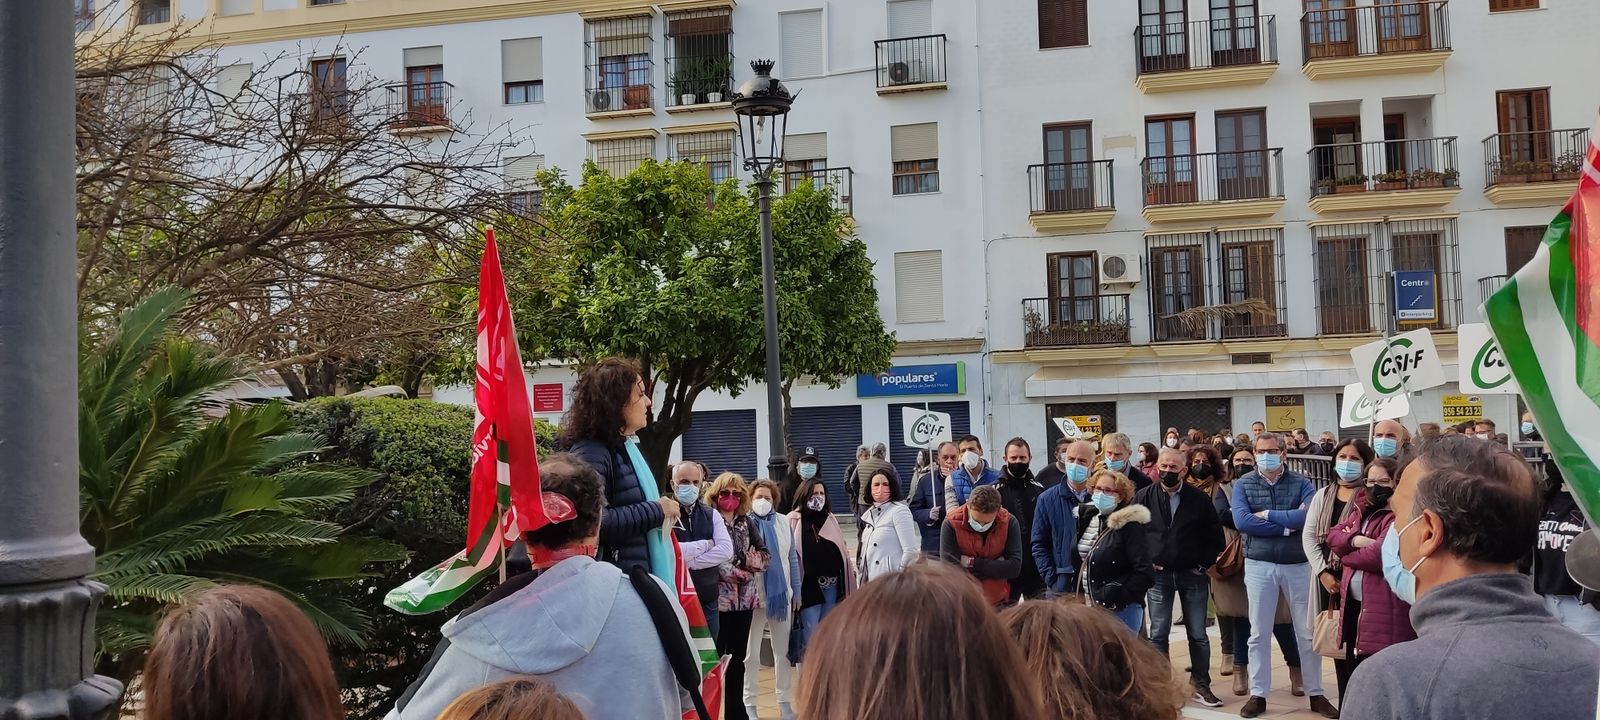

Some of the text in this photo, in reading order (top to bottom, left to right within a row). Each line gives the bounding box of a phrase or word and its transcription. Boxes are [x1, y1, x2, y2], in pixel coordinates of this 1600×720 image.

[881, 373, 935, 386] populares
[1443, 407, 1482, 416] 956 54 23 23
